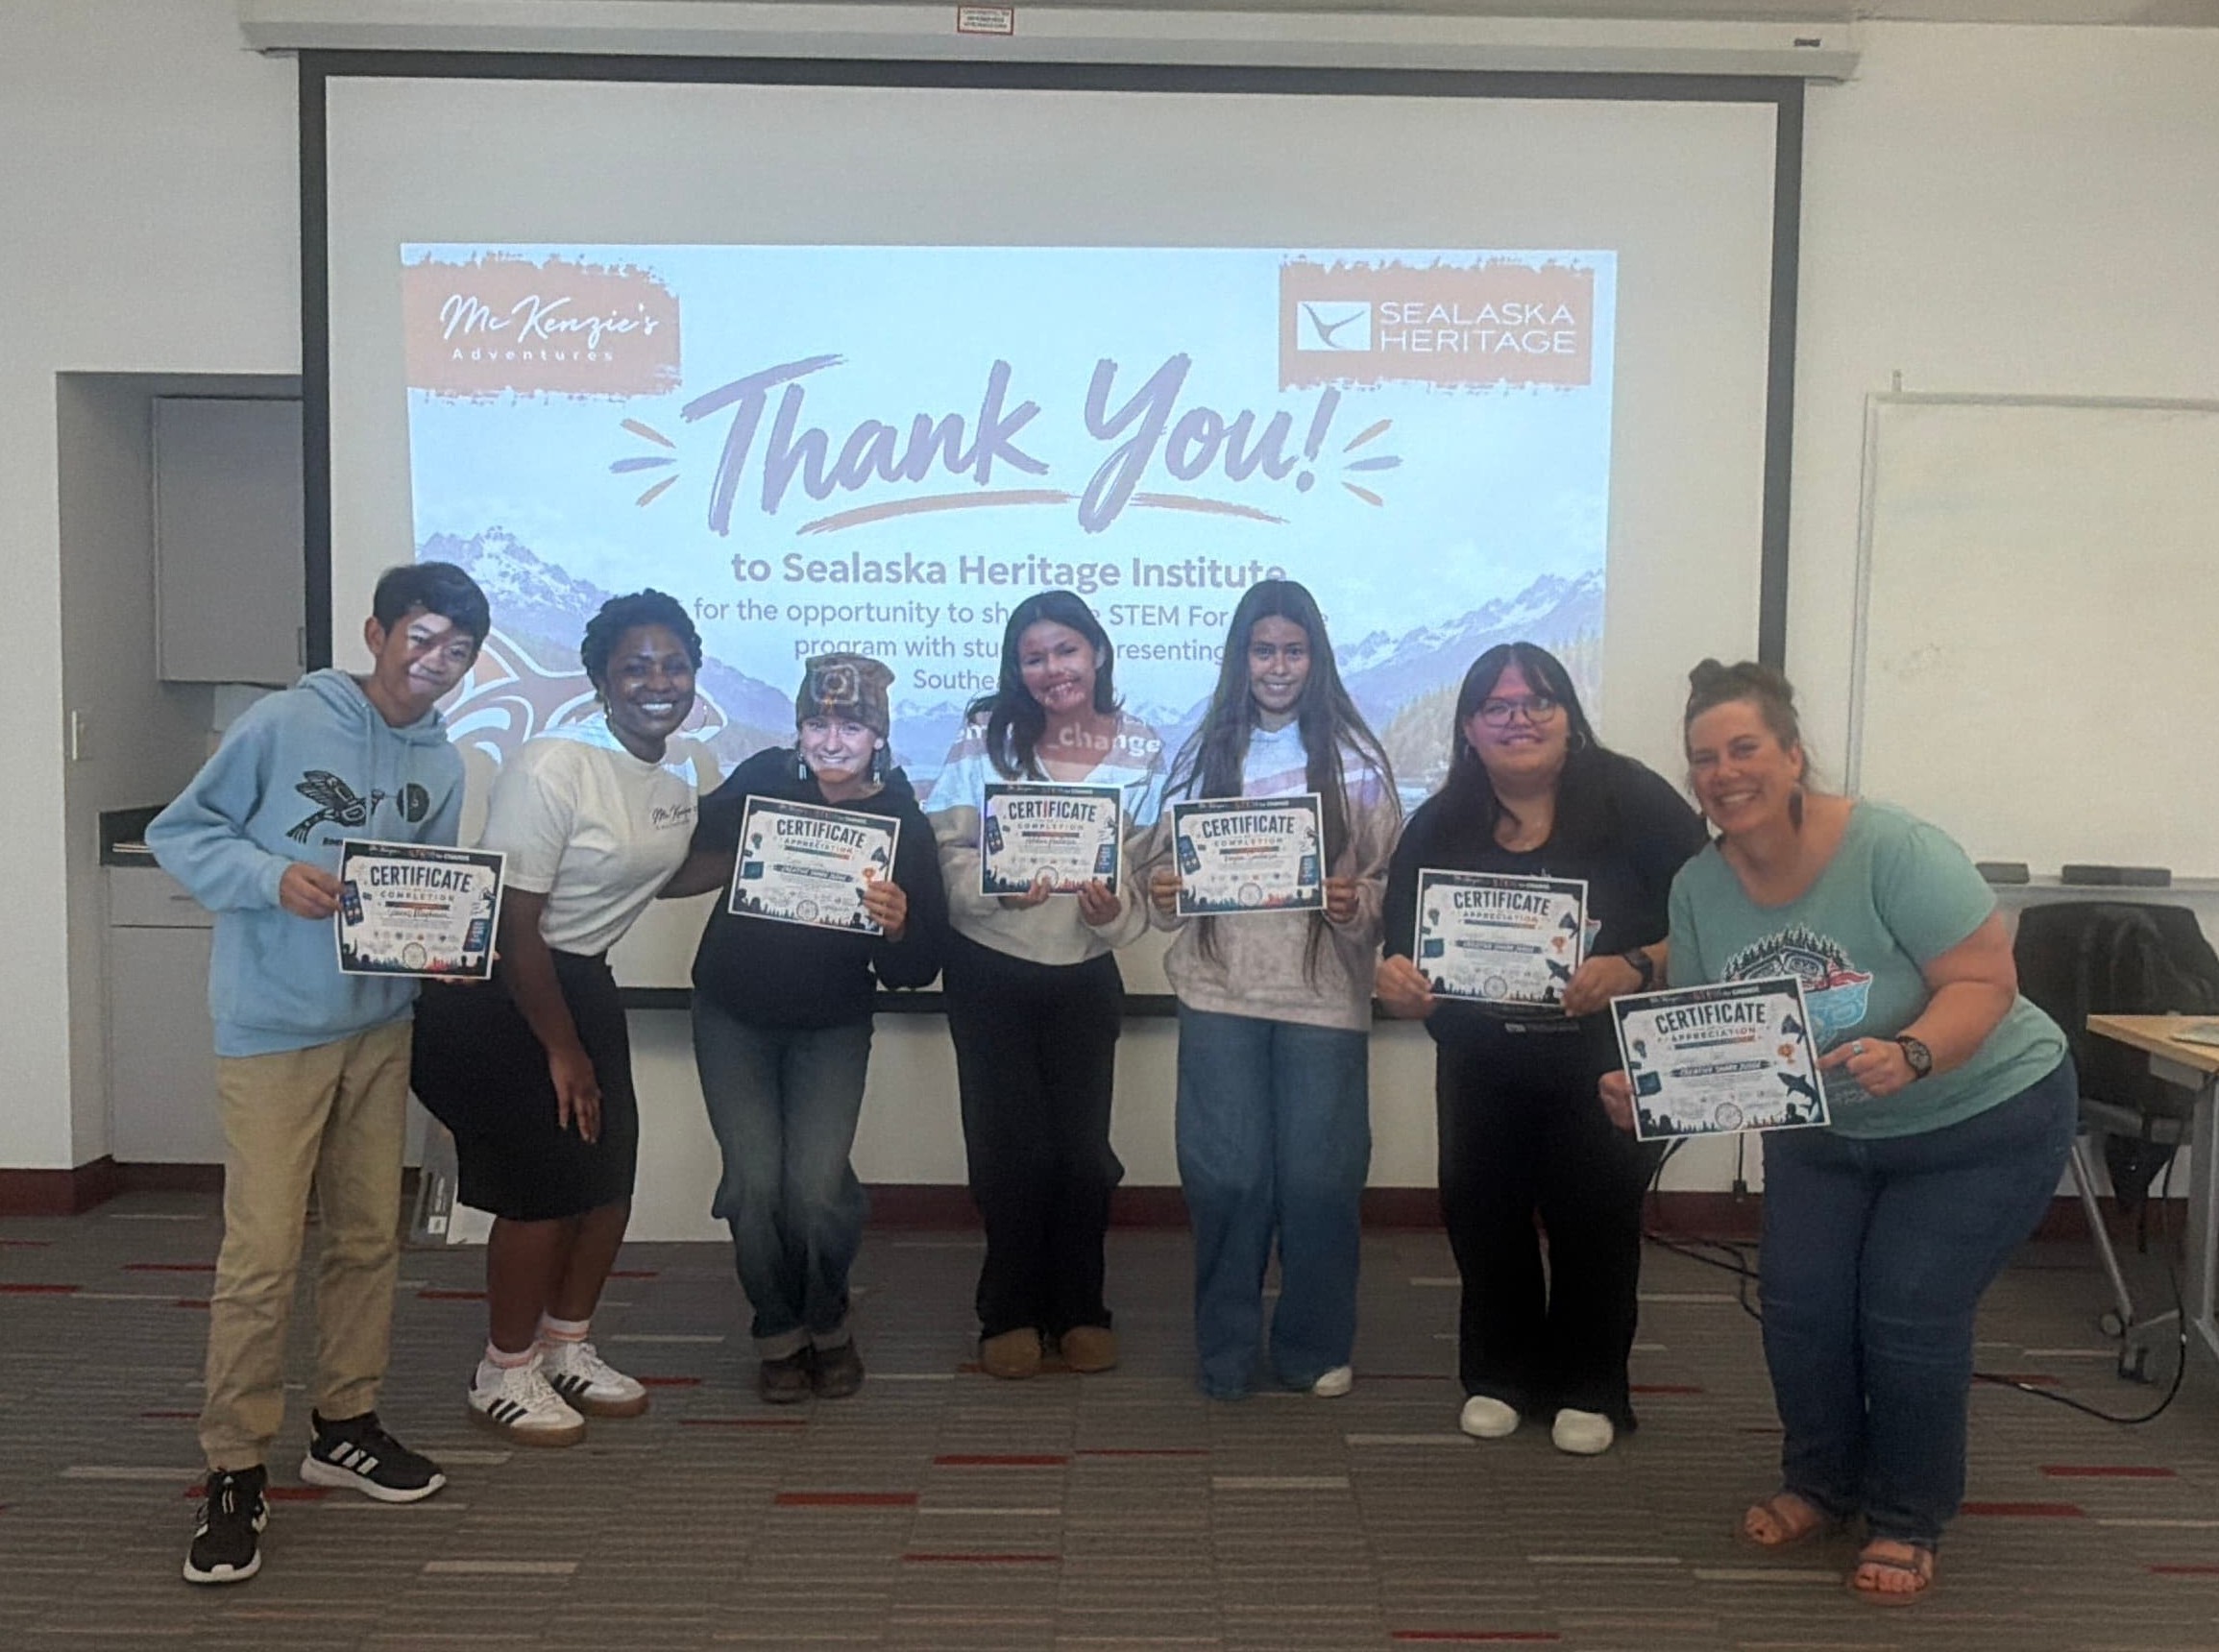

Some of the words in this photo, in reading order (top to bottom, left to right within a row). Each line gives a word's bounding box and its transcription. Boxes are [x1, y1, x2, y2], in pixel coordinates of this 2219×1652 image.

[1379, 302, 1575, 325] SEALASKA
[1380, 329, 1577, 353] HERITAGE
[451, 348, 614, 361] Adventures
[681, 353, 1050, 537] Thank
[1078, 352, 1341, 533] You!
[732, 553, 771, 582] to
[783, 551, 946, 584] Sealaska
[960, 553, 1120, 595] Heritage
[695, 597, 729, 620] for
[737, 597, 778, 621] the
[787, 600, 940, 627] opportunity
[948, 603, 974, 624] to
[1109, 604, 1181, 627] STEM
[1189, 605, 1229, 627] For
[795, 638, 897, 661] program
[905, 636, 956, 658] with
[1009, 800, 1097, 823] CERTIFICATE
[777, 818, 866, 849] CERTIFICATE
[1202, 814, 1295, 839] CERTIFICATE
[370, 865, 473, 893] CERTIFICATE
[380, 889, 454, 902] COMPLETION
[1453, 890, 1551, 916] CERTIFICATE
[1655, 1002, 1766, 1034] CERTIFICATE
[1671, 1027, 1756, 1042] APPRECIATION
